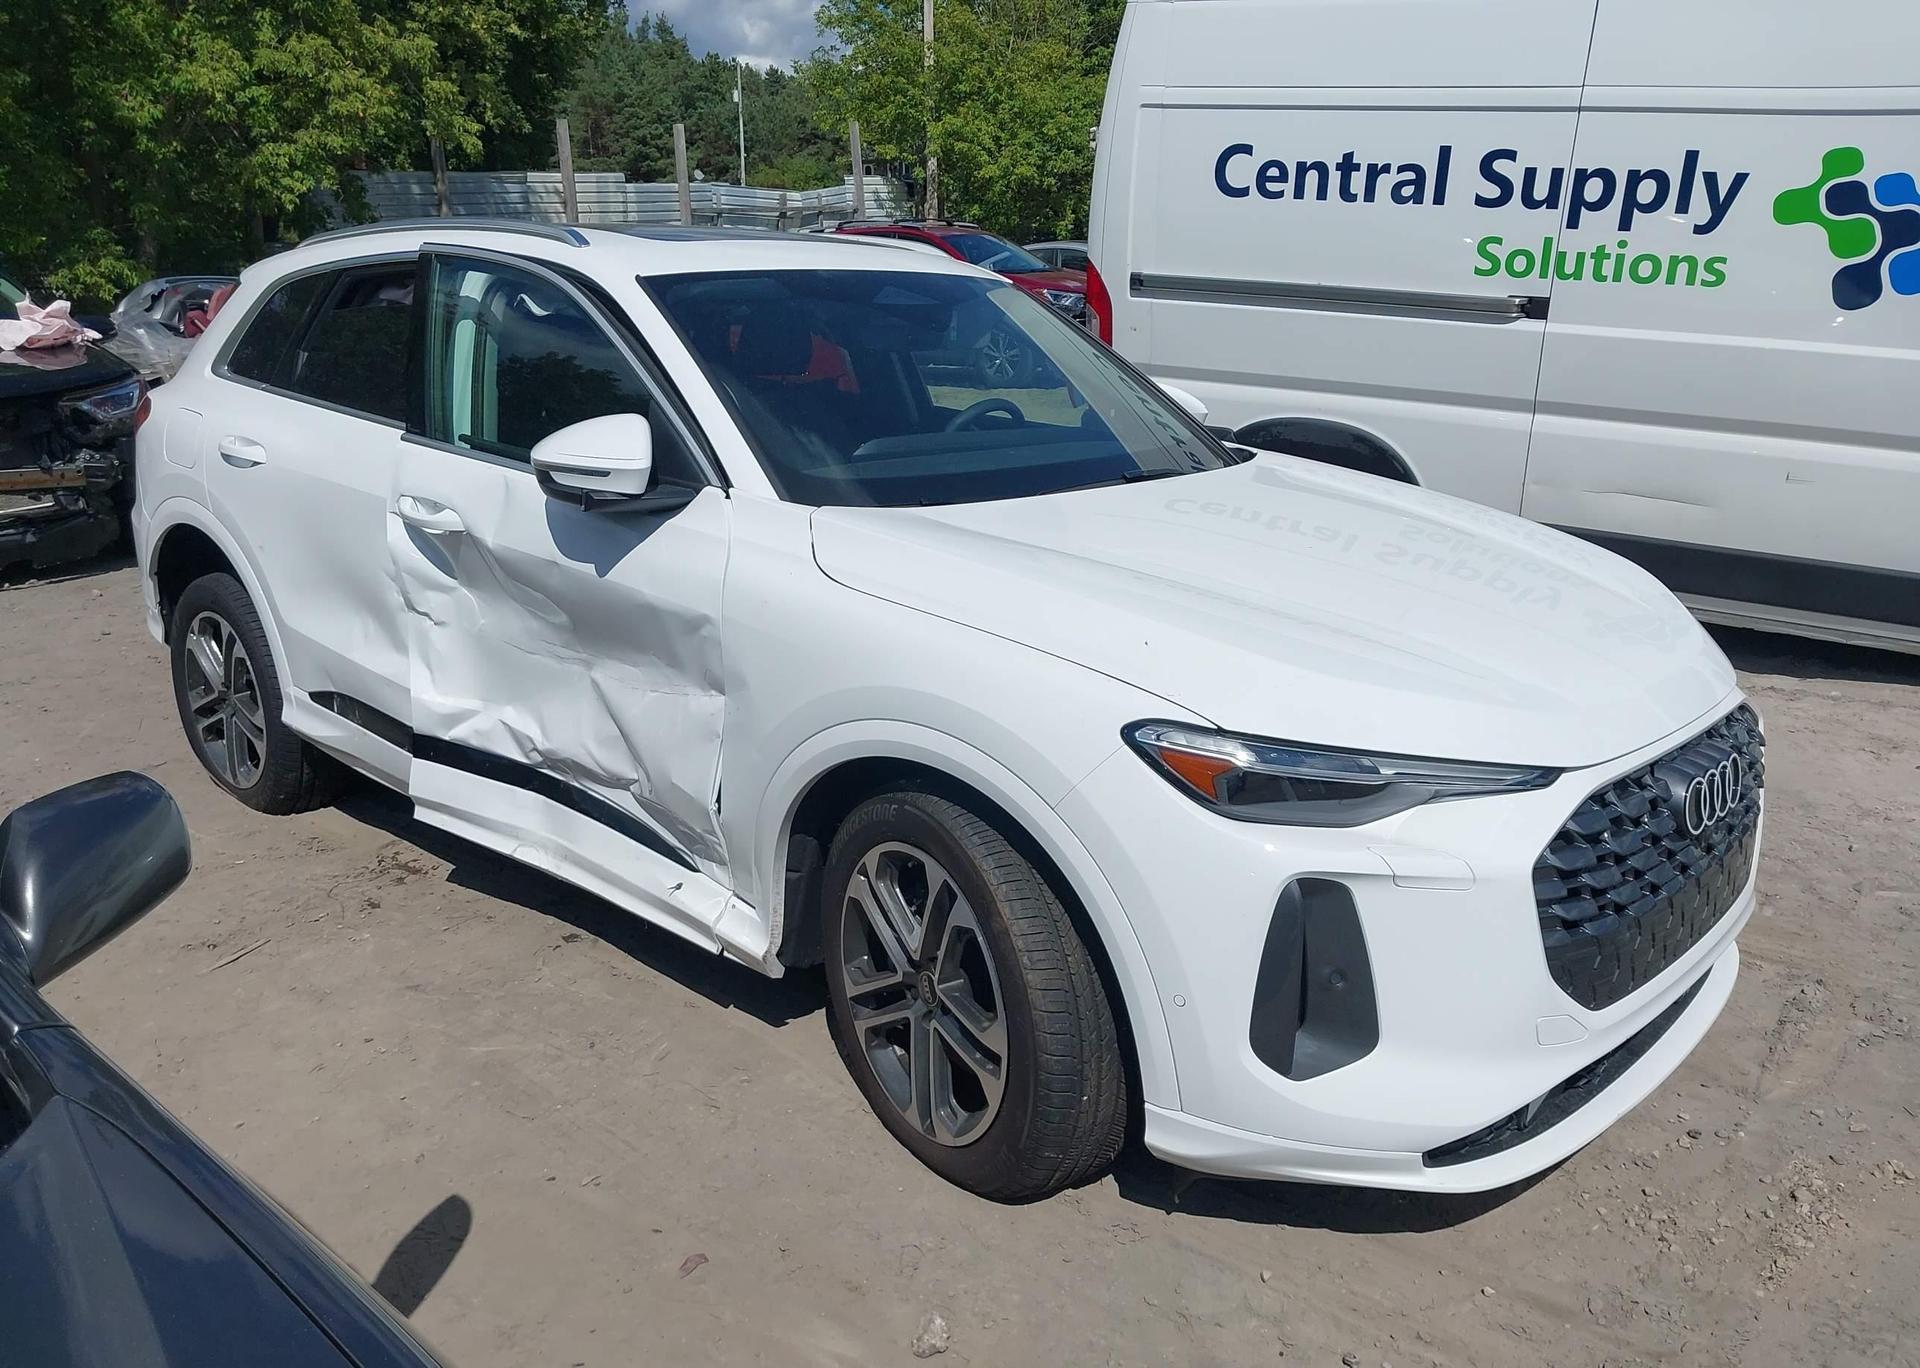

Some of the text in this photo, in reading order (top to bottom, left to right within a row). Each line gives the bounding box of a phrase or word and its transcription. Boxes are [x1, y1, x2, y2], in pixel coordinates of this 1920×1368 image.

[1214, 143, 1751, 236] Central Supply
[1472, 235, 1729, 289] Solutions
